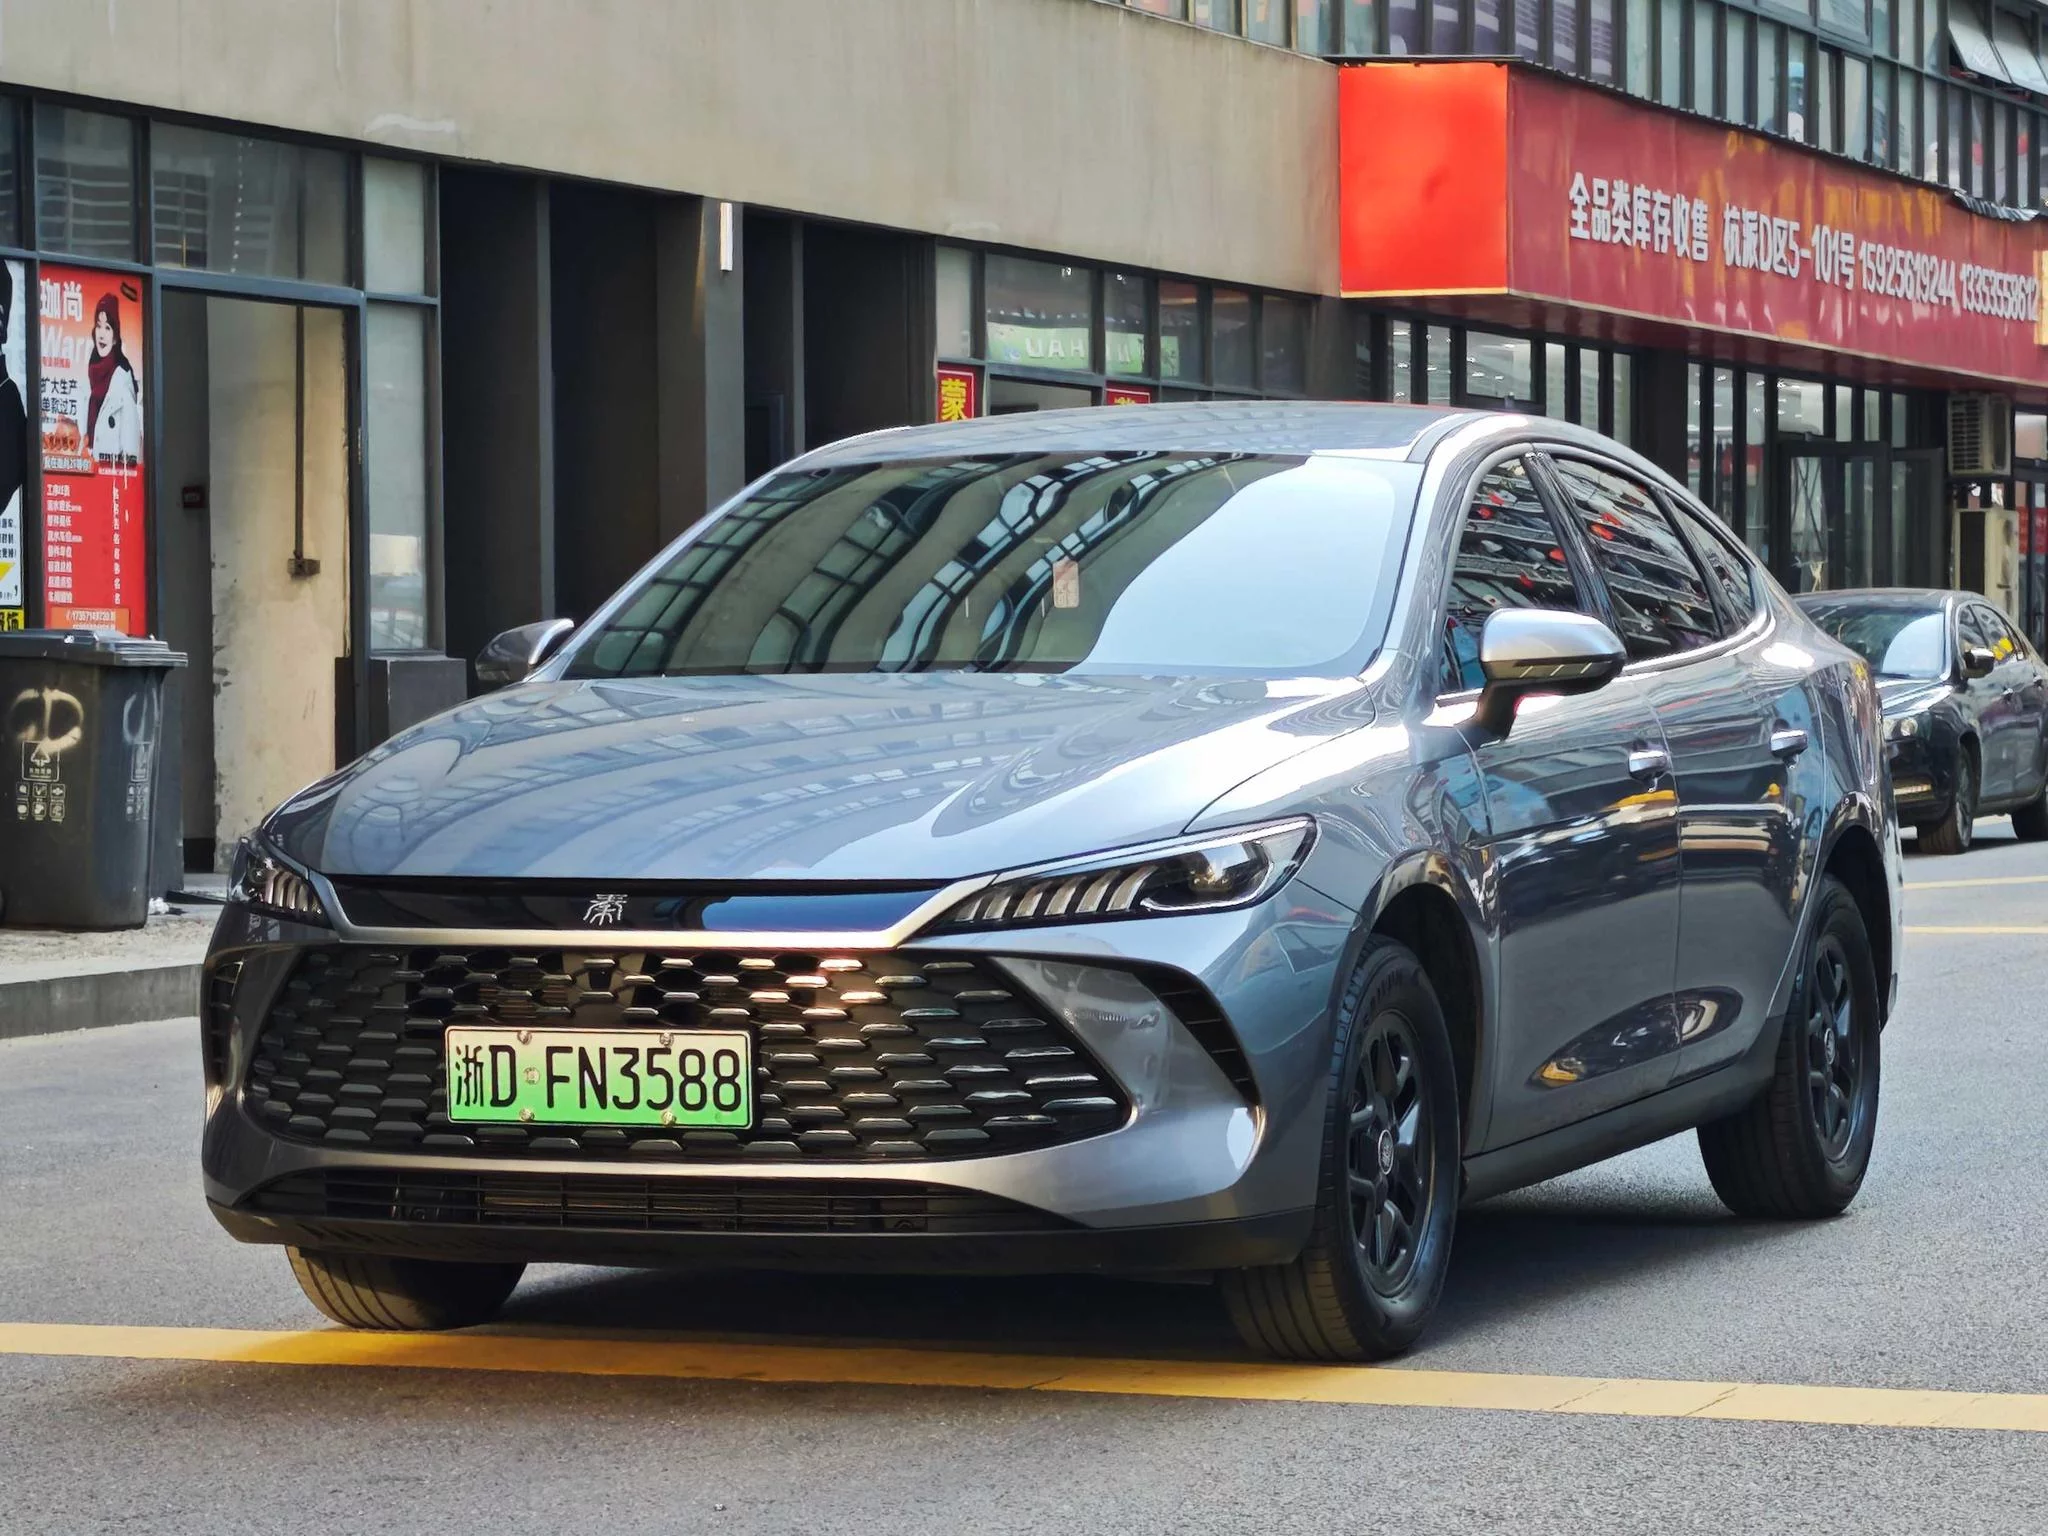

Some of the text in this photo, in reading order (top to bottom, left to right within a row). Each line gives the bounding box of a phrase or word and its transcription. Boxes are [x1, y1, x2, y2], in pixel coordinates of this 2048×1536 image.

[1569, 171, 1709, 262] 全品类库存收售
[1723, 202, 1855, 291] 杭派D区5-101号
[1859, 240, 1958, 306] 15925619244
[941, 378, 967, 421] 蒙
[455, 1044, 741, 1112] 浙D FN3588
